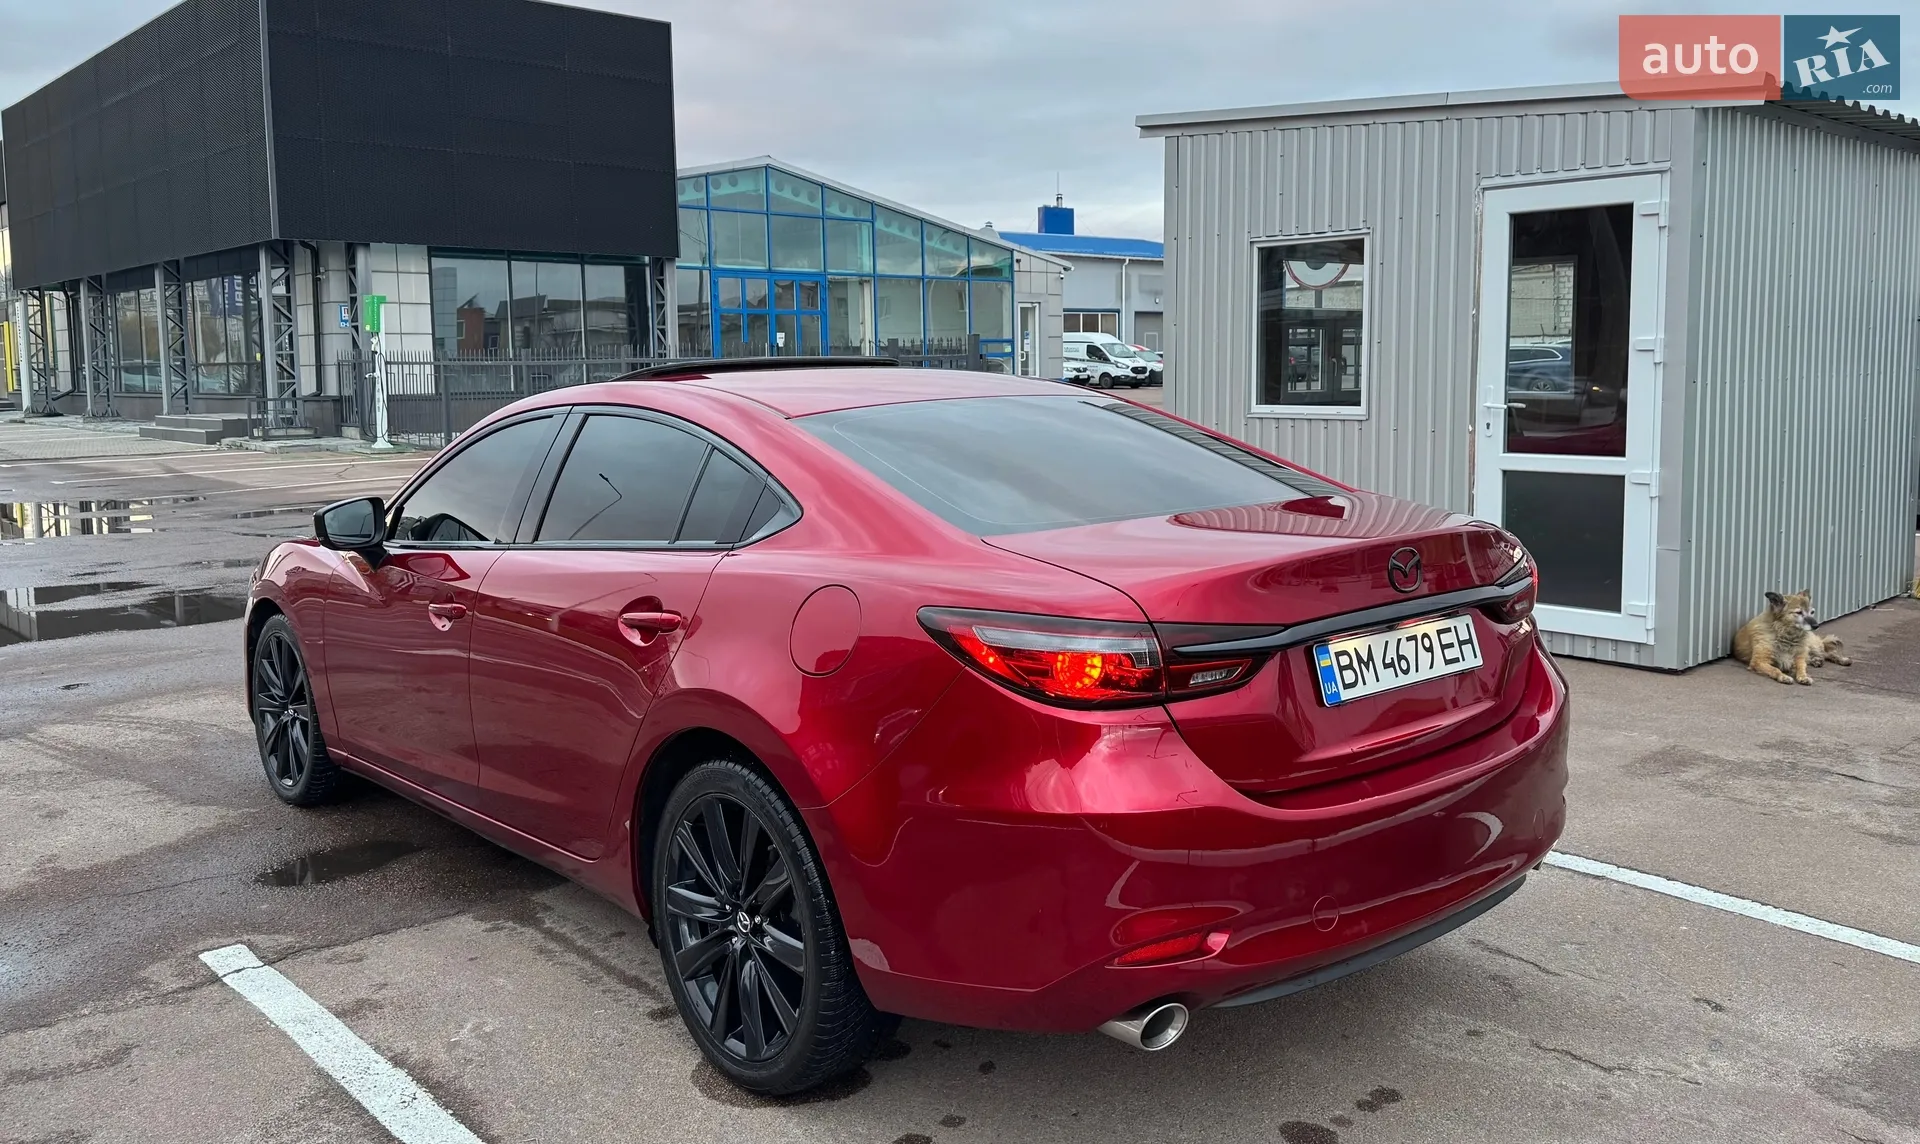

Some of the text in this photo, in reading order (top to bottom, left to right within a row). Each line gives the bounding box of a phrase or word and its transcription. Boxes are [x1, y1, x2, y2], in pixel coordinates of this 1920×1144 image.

[1334, 623, 1478, 690] BM 4679 EH
[1325, 682, 1339, 694] UA
